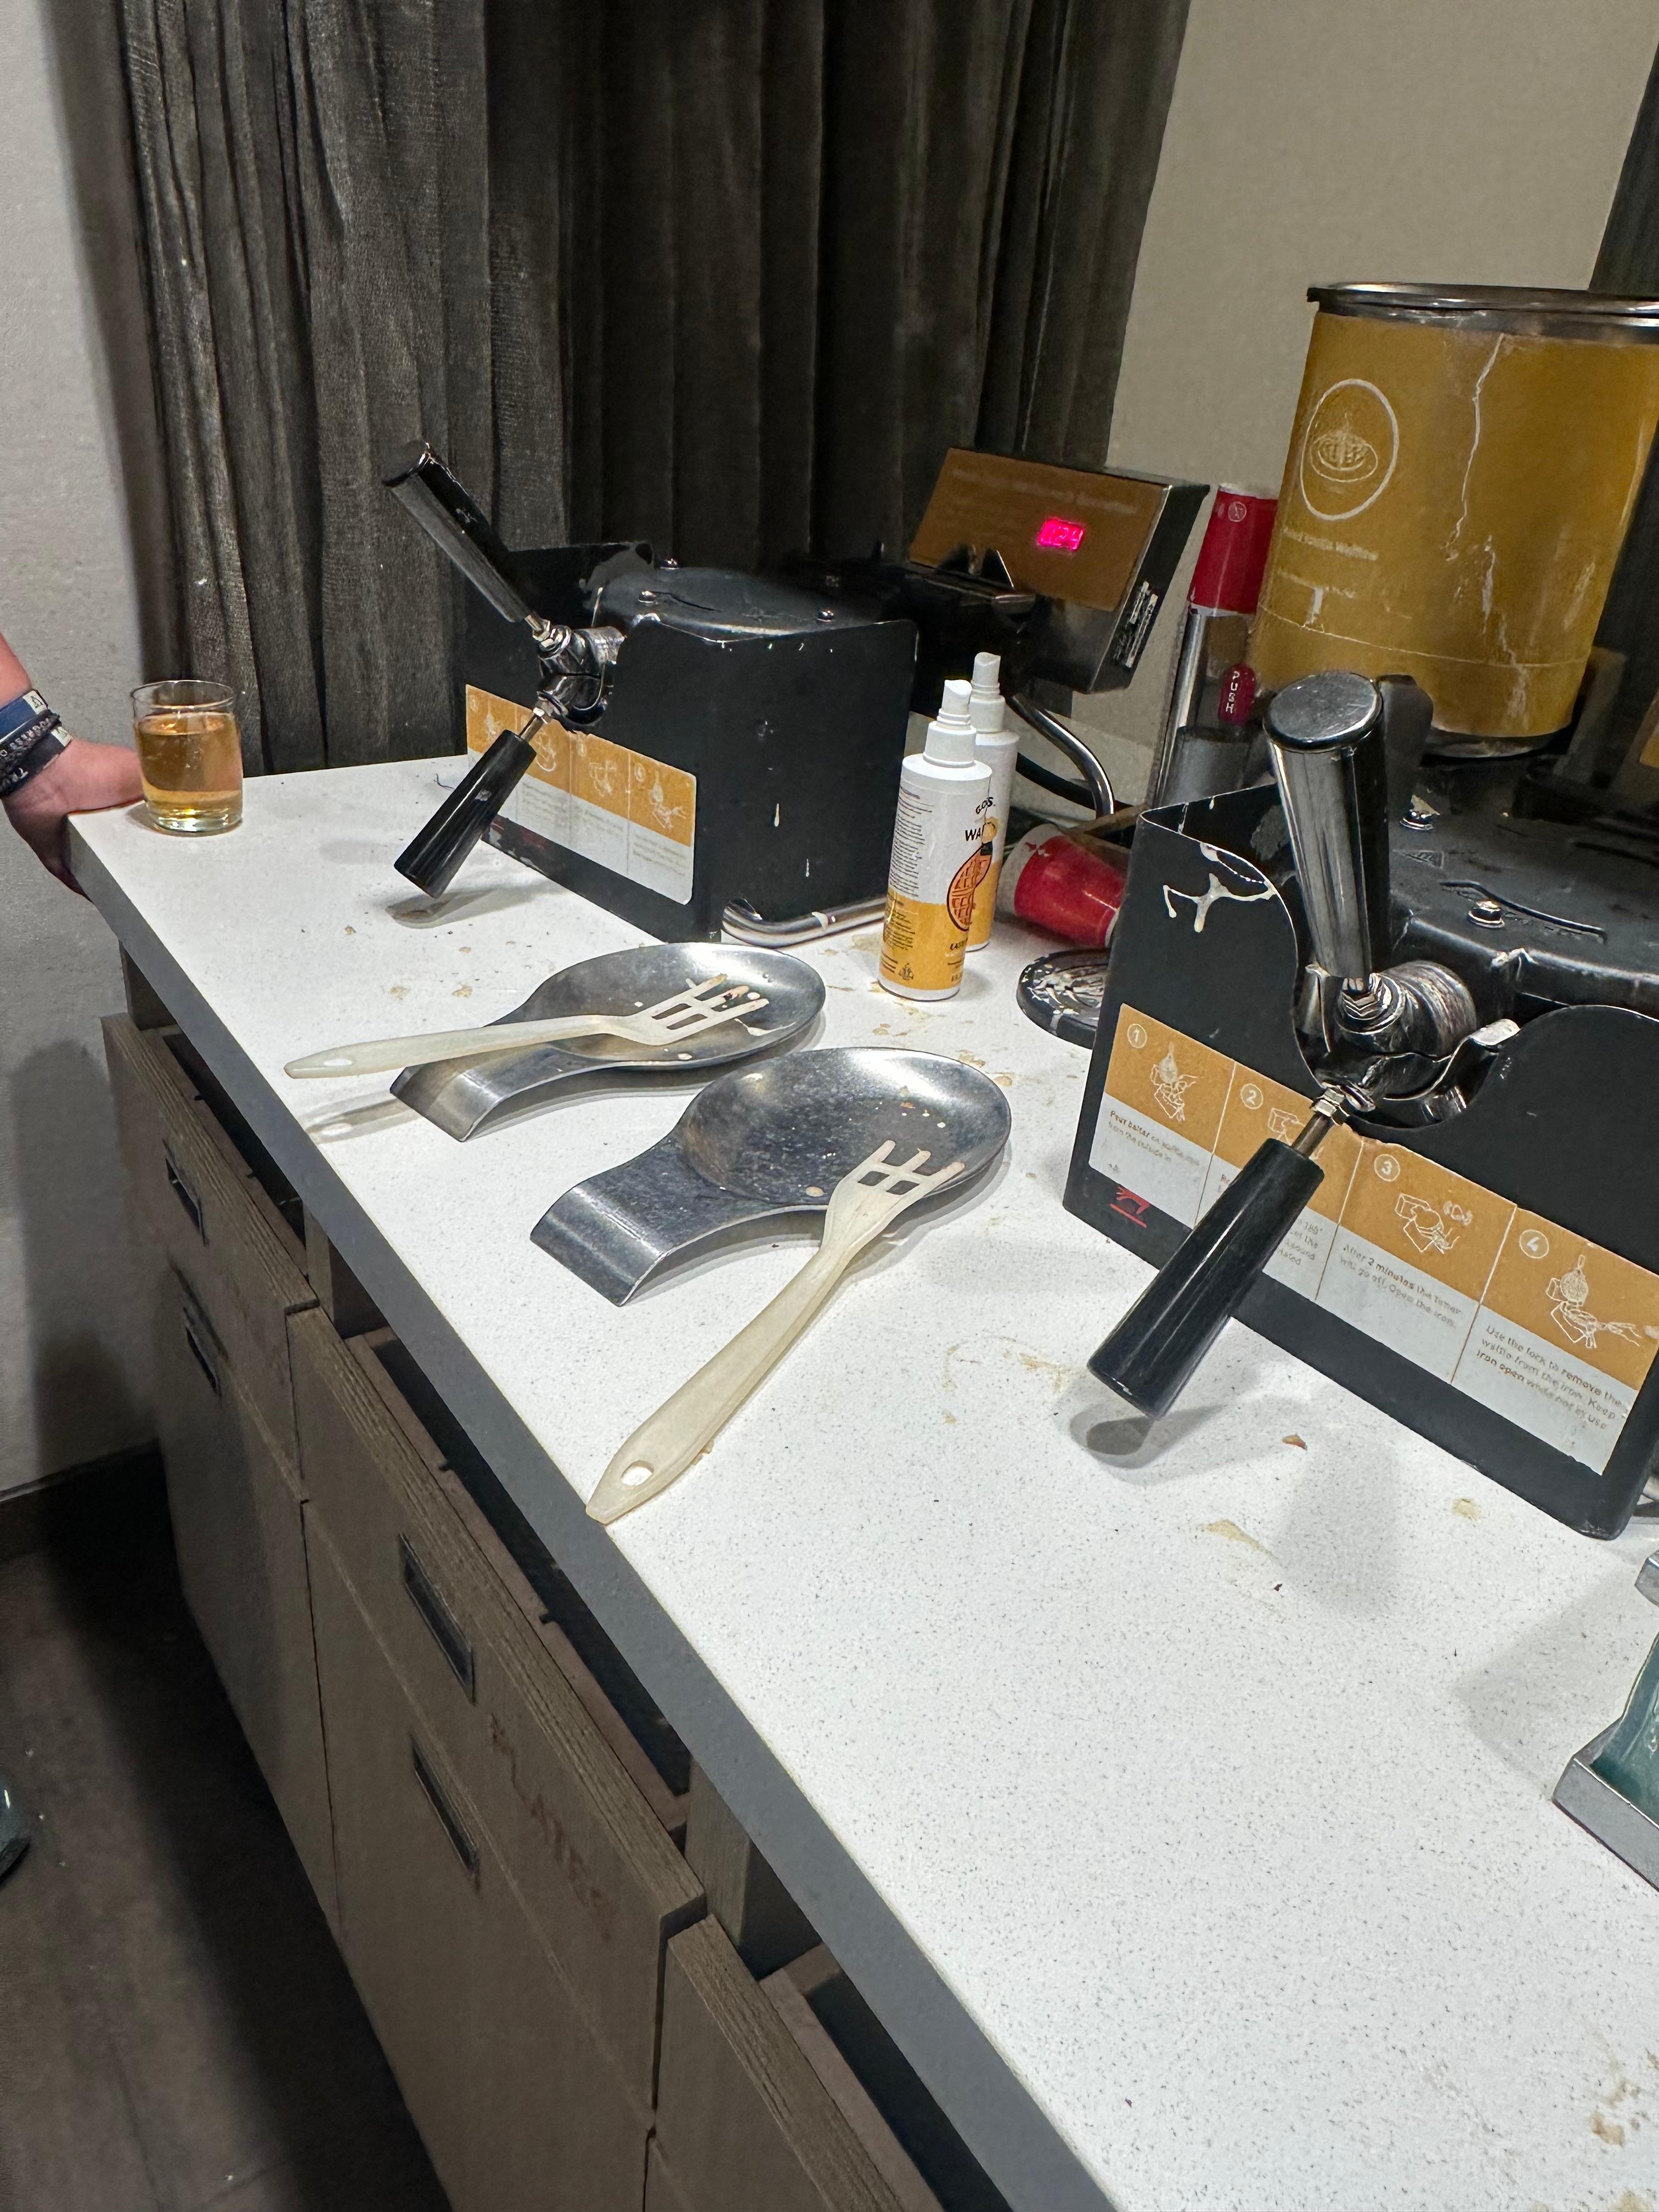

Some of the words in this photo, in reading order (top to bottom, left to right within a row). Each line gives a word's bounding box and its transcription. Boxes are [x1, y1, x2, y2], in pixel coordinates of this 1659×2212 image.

[1225, 670, 1240, 714] PUSH
[1246, 1090, 1256, 1105] 2
[1381, 1160, 1392, 1176] 3
[1343, 1244, 1366, 1262] After
[1368, 1257, 1375, 1266] 2
[1376, 1263, 1414, 1290] minutes
[1417, 1285, 1432, 1300] the
[1416, 1299, 1431, 1313] the
[1476, 1348, 1497, 1366] iron
[1499, 1363, 1525, 1382] open
[1486, 1325, 1505, 1341] Use
[1508, 1338, 1523, 1352] the
[1549, 1361, 1559, 1371] to
[1561, 1369, 1602, 1396] remove
[1604, 1391, 1622, 1406] the
[1514, 1356, 1539, 1376] from
[1542, 1371, 1559, 1387] the
[1588, 1398, 1616, 1420] Keep
